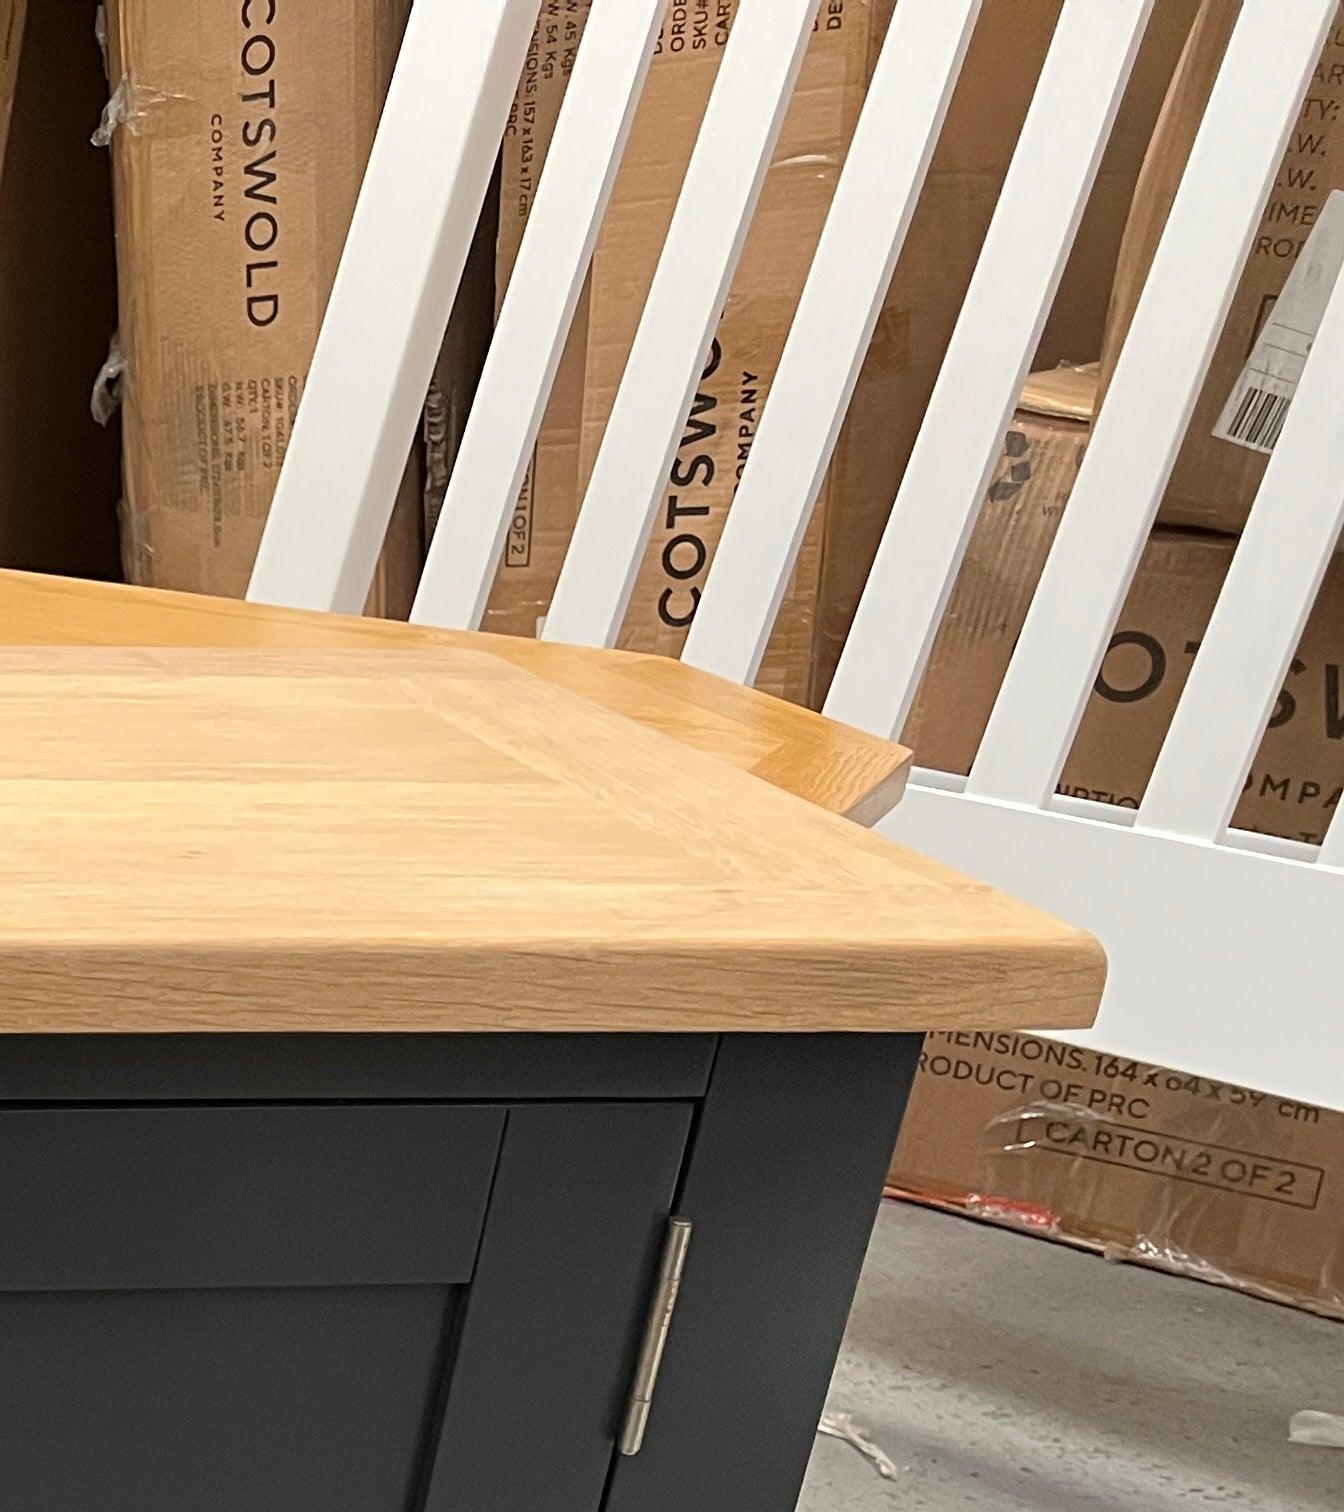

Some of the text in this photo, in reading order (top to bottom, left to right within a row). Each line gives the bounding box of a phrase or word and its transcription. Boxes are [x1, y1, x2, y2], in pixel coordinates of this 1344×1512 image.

[545, 25, 559, 44] 54
[542, 51, 556, 80] Kgs
[523, 101, 536, 125] 157
[1303, 98, 1339, 120] TY:
[521, 138, 534, 163] 163
[210, 113, 226, 222] COMPANY
[241, 0, 278, 327] COTSWOLD
[520, 177, 532, 191] 17
[518, 194, 528, 217] cm
[513, 515, 527, 540] OF
[512, 543, 525, 554] 2
[1095, 1055, 1138, 1082] 164
[919, 1052, 1150, 1119] RODUCT OF PRC
[1045, 1121, 1297, 1195] CARTON 2 OF 2
